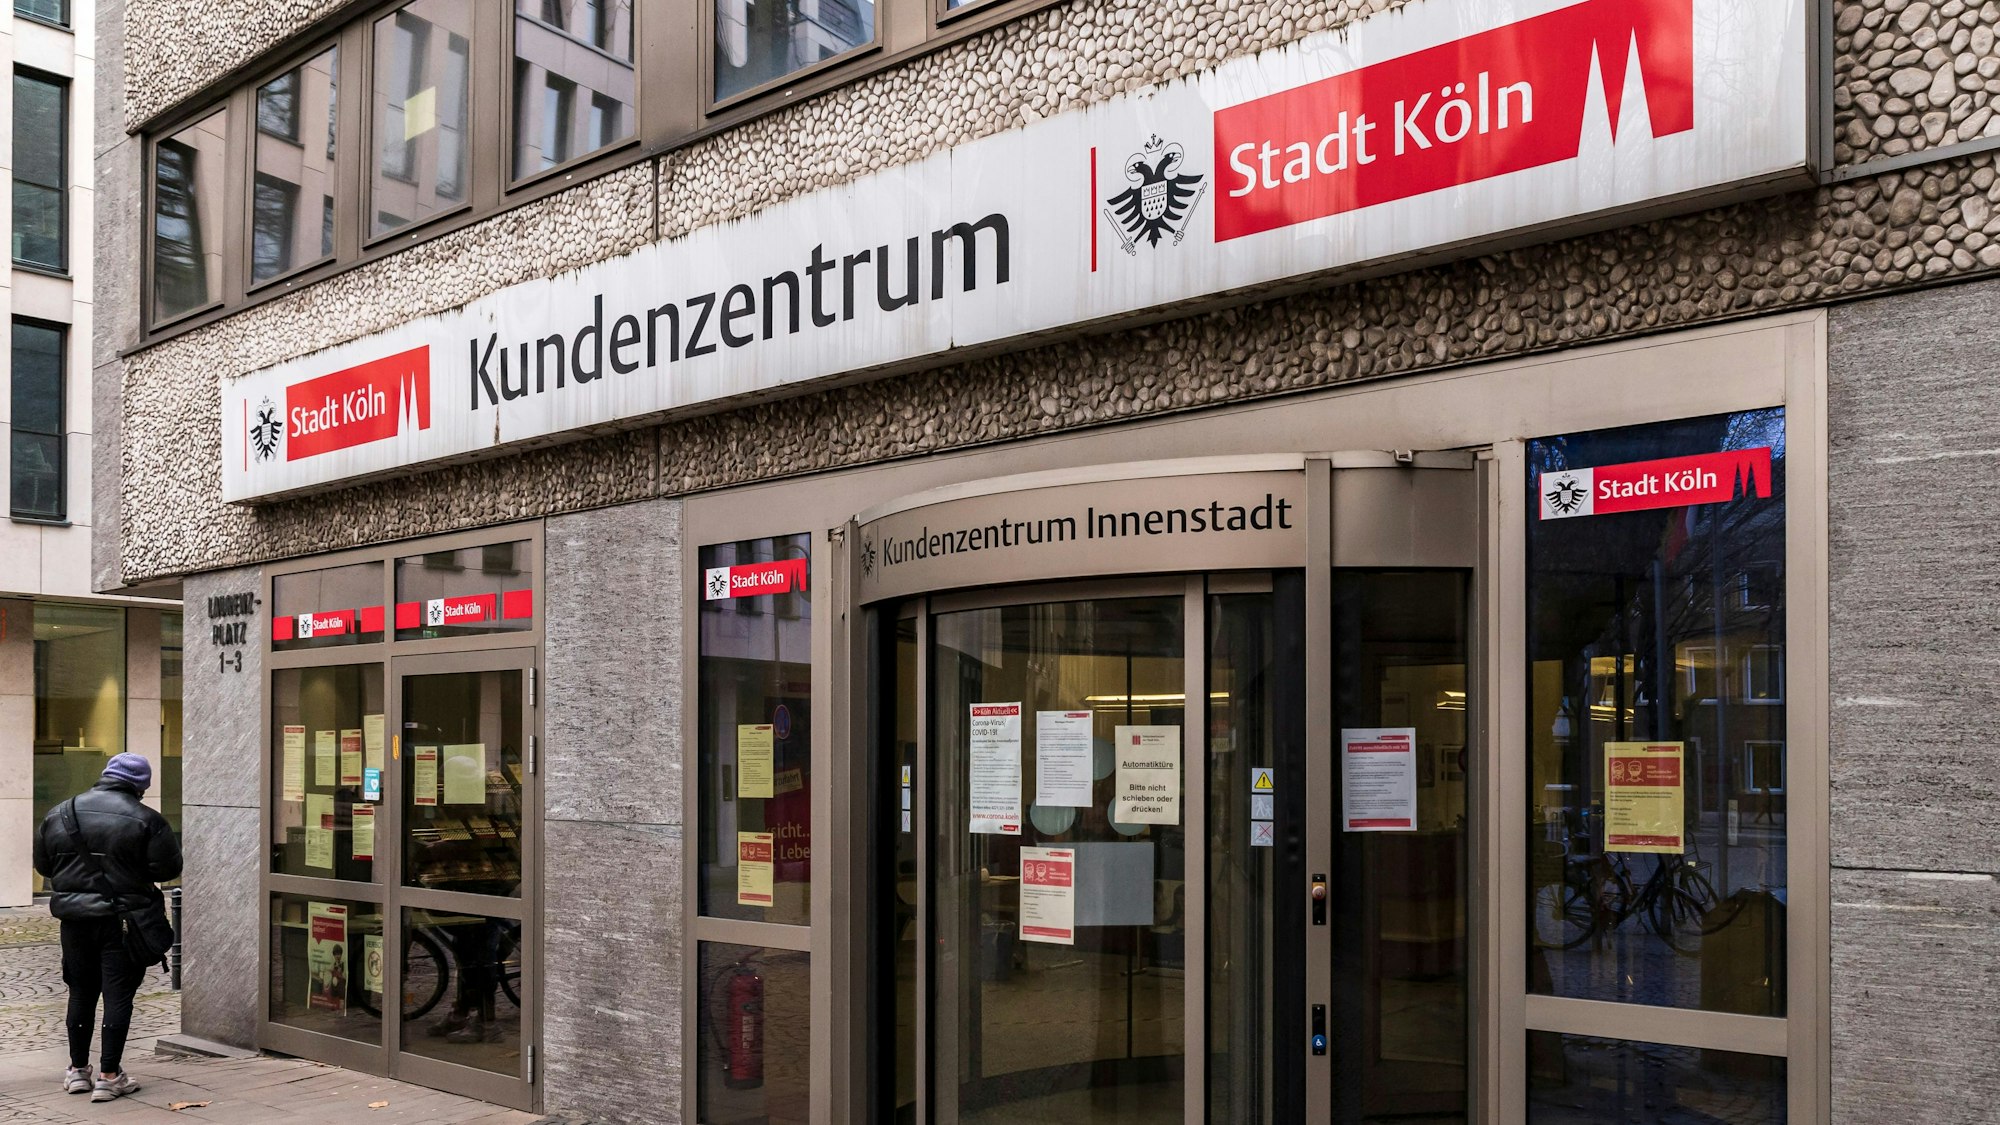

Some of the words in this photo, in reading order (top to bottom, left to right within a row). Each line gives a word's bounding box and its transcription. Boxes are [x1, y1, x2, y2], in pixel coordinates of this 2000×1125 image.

[1229, 111, 1376, 197] Stadt
[1394, 71, 1533, 156] Köln
[469, 213, 1010, 410] Kundenzentrum
[291, 395, 339, 438] Stadt
[343, 383, 386, 424] Köln
[1598, 473, 1659, 500] Stadt
[1664, 467, 1717, 493] Köln
[883, 507, 1076, 567] Kundenzentrum
[1087, 493, 1292, 538] Innenstadt
[731, 572, 759, 588] Stadt
[760, 569, 784, 586] Köln
[444, 604, 463, 617] Stadt
[464, 602, 481, 615] Köln
[212, 621, 247, 646] PLATZ
[313, 618, 328, 630] Stadt
[329, 617, 343, 629] Köln
[1122, 760, 1174, 768] Automatiktüre
[1129, 783, 1146, 791] Bitte
[1131, 805, 1163, 813] drücken!
